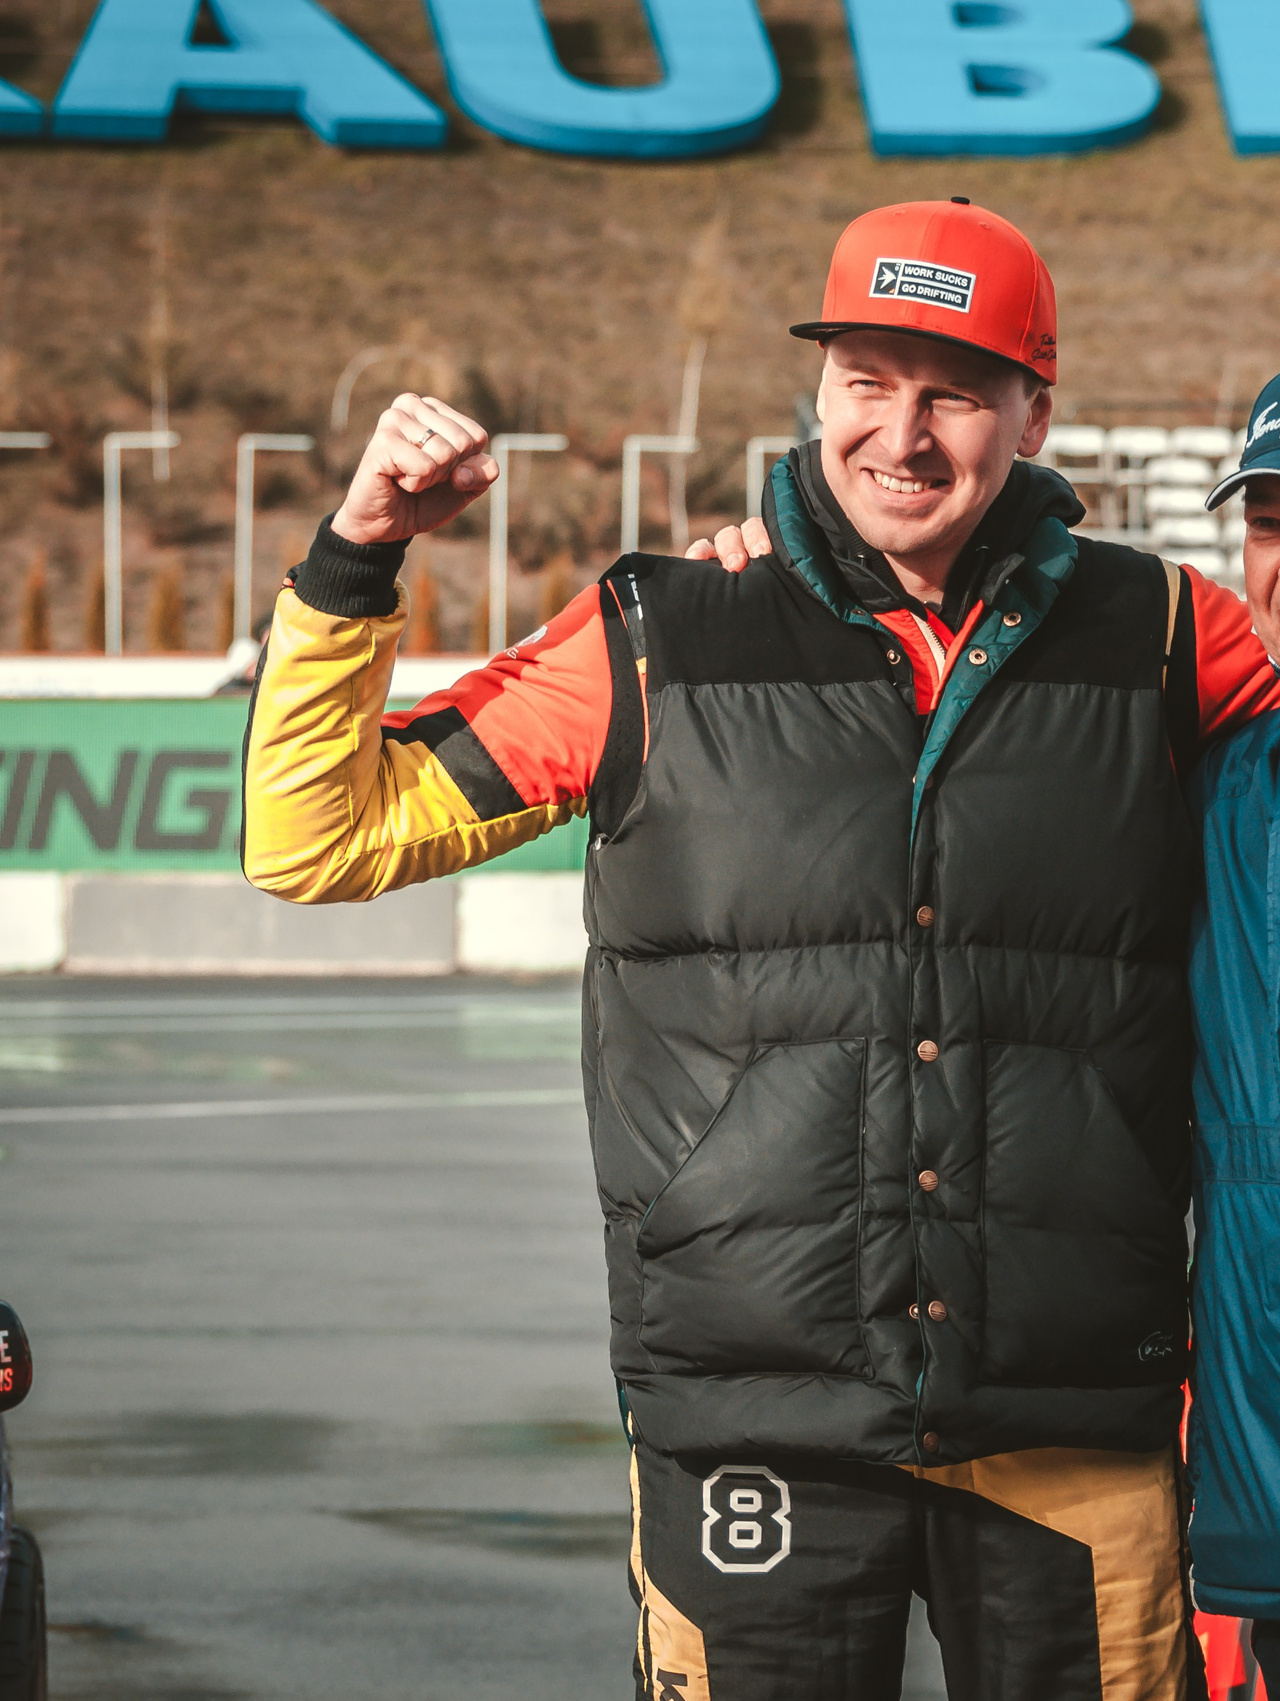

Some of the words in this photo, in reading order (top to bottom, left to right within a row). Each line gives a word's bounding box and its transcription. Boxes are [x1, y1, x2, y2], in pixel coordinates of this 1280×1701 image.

[904, 265, 934, 279] WORK
[934, 271, 968, 288] SUCKS
[901, 283, 917, 294] GO
[916, 286, 963, 304] DRIFTING
[702, 1464, 792, 1573] 8
